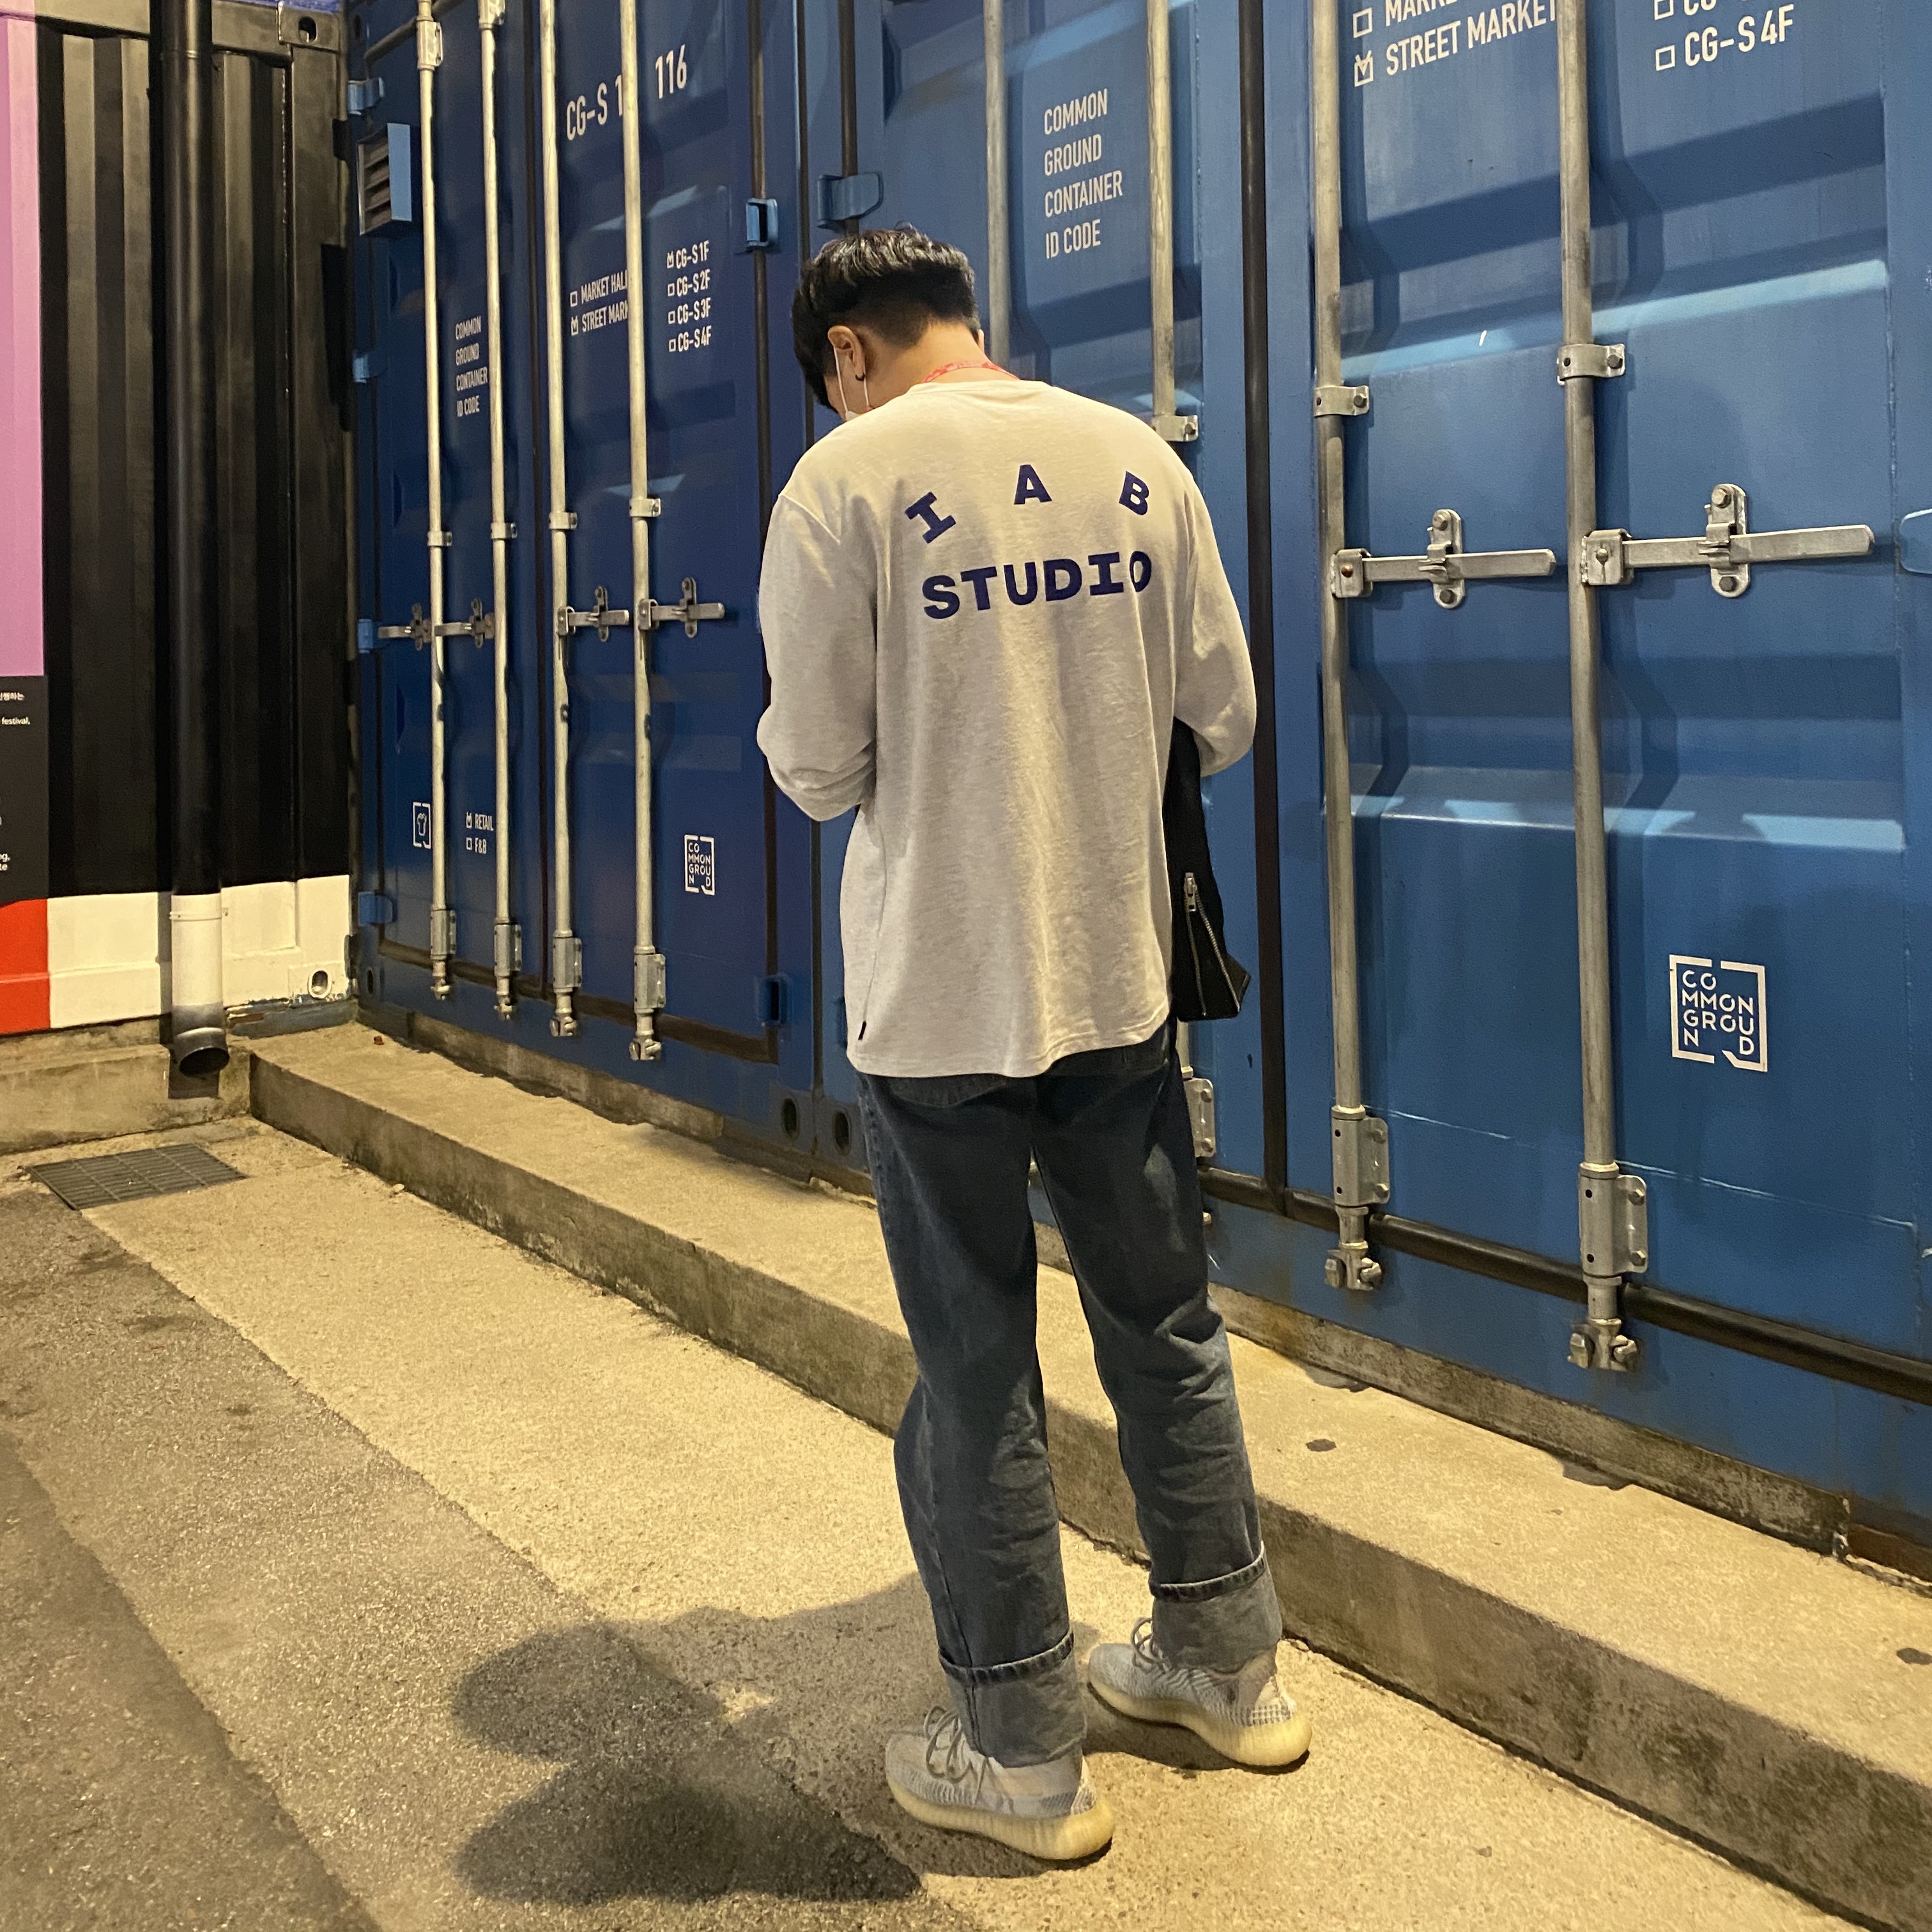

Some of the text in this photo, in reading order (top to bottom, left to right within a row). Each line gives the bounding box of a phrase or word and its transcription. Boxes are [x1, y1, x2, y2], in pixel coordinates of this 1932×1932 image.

[1386, 20, 1461, 75] STREET
[656, 43, 687, 99] 116
[1044, 88, 1108, 135] COMMON
[1044, 134, 1101, 176] GROUND
[1045, 170, 1123, 217] CONTAINER
[1045, 218, 1101, 259] ID CODE
[581, 276, 610, 305] MARKET
[456, 316, 482, 340] COMMON
[582, 306, 607, 332] STREET
[456, 342, 479, 365] GROUND
[456, 366, 488, 392] CONTAINER
[457, 395, 480, 417] ID CODE
[923, 551, 1151, 619] STUDIO
[1, 716, 31, 725] festival.
[475, 813, 494, 831] RETAIL
[475, 837, 487, 855] F&B
